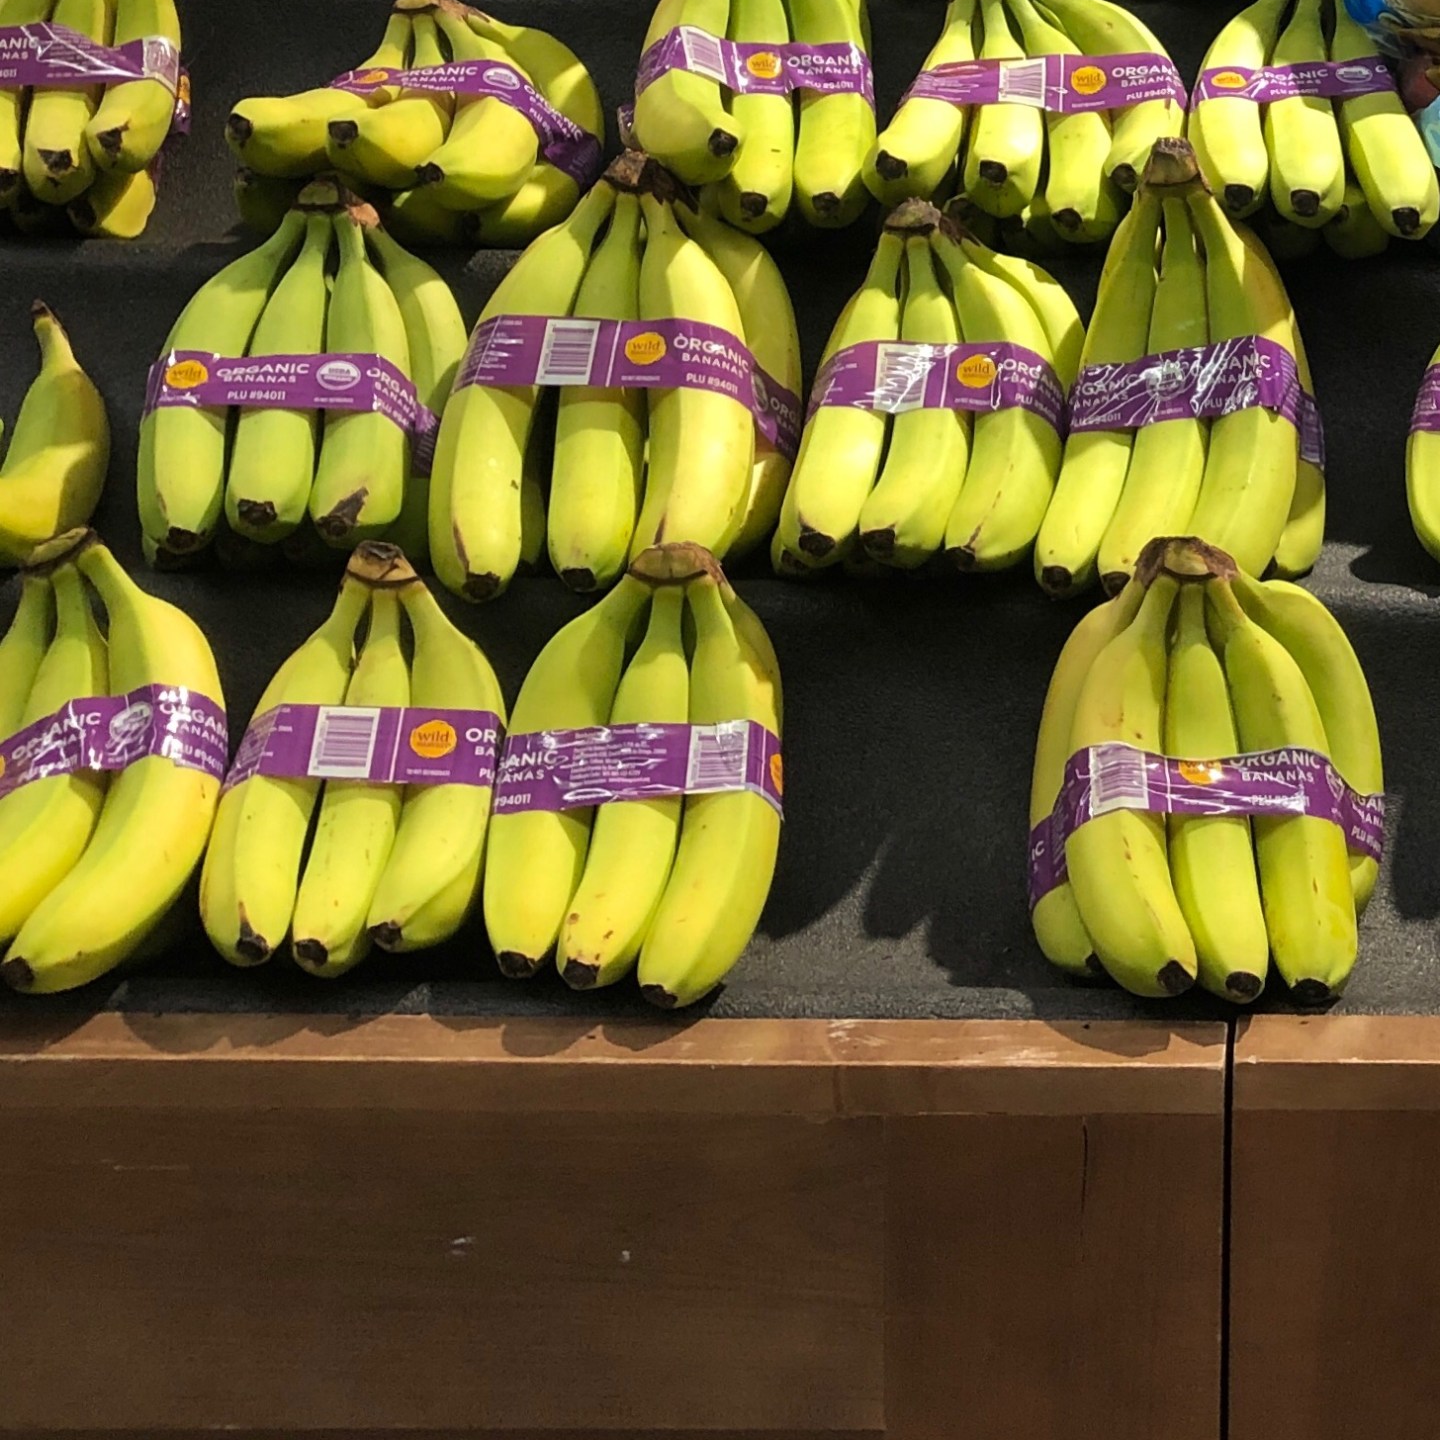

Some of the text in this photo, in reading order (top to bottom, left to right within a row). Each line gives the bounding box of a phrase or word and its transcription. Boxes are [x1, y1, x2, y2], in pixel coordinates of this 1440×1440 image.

[1075, 73, 1103, 85] wild
[631, 339, 661, 353] wild
[673, 332, 749, 373] ORGANIC
[216, 363, 310, 377] ORGANIC
[681, 353, 744, 380] BANANAS
[962, 363, 991, 375] wild
[223, 374, 297, 384] BANANAS
[686, 372, 738, 395] PLU #94011
[1074, 372, 1138, 397] RGANIC
[227, 389, 287, 402] PLU #94011
[1015, 392, 1032, 406] PLU
[417, 729, 451, 744] wild
[1242, 770, 1315, 784] BANANAS
